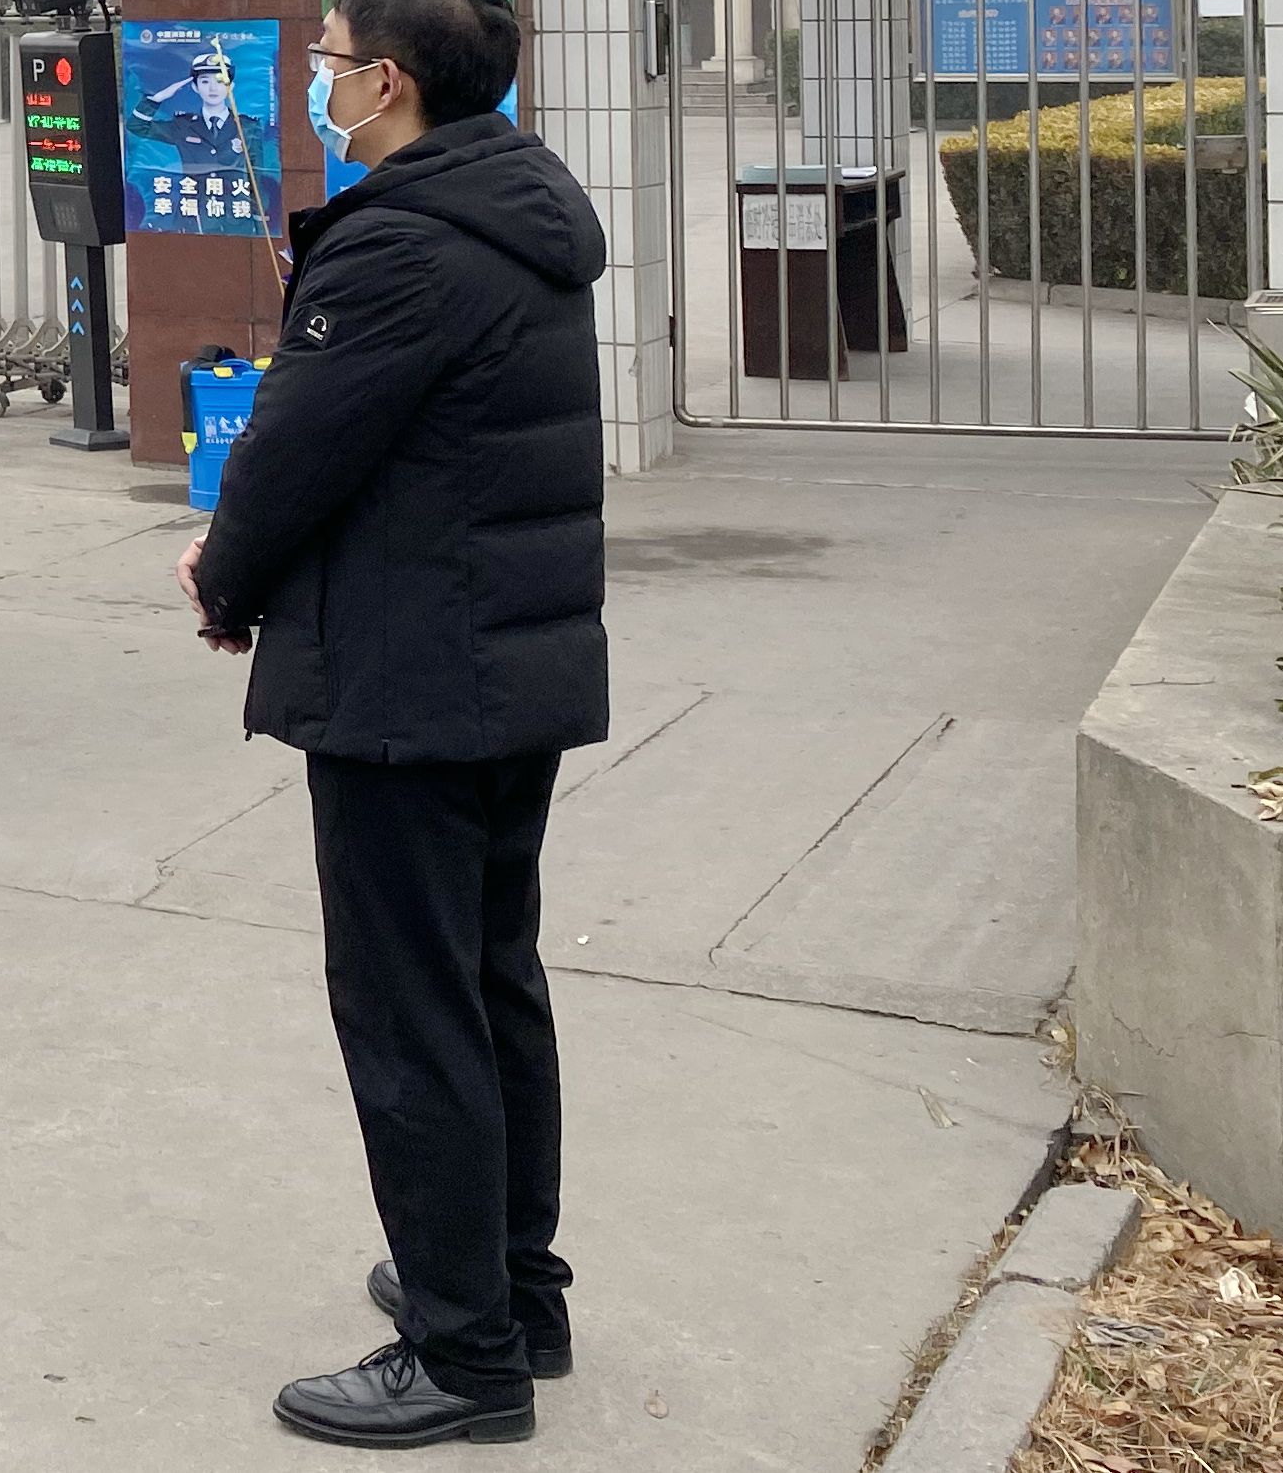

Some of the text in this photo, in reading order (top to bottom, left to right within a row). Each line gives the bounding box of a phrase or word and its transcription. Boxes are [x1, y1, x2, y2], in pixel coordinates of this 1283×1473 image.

[32, 58, 46, 83] P
[153, 176, 252, 197] 安全用火
[153, 196, 253, 220] 幸福你我
